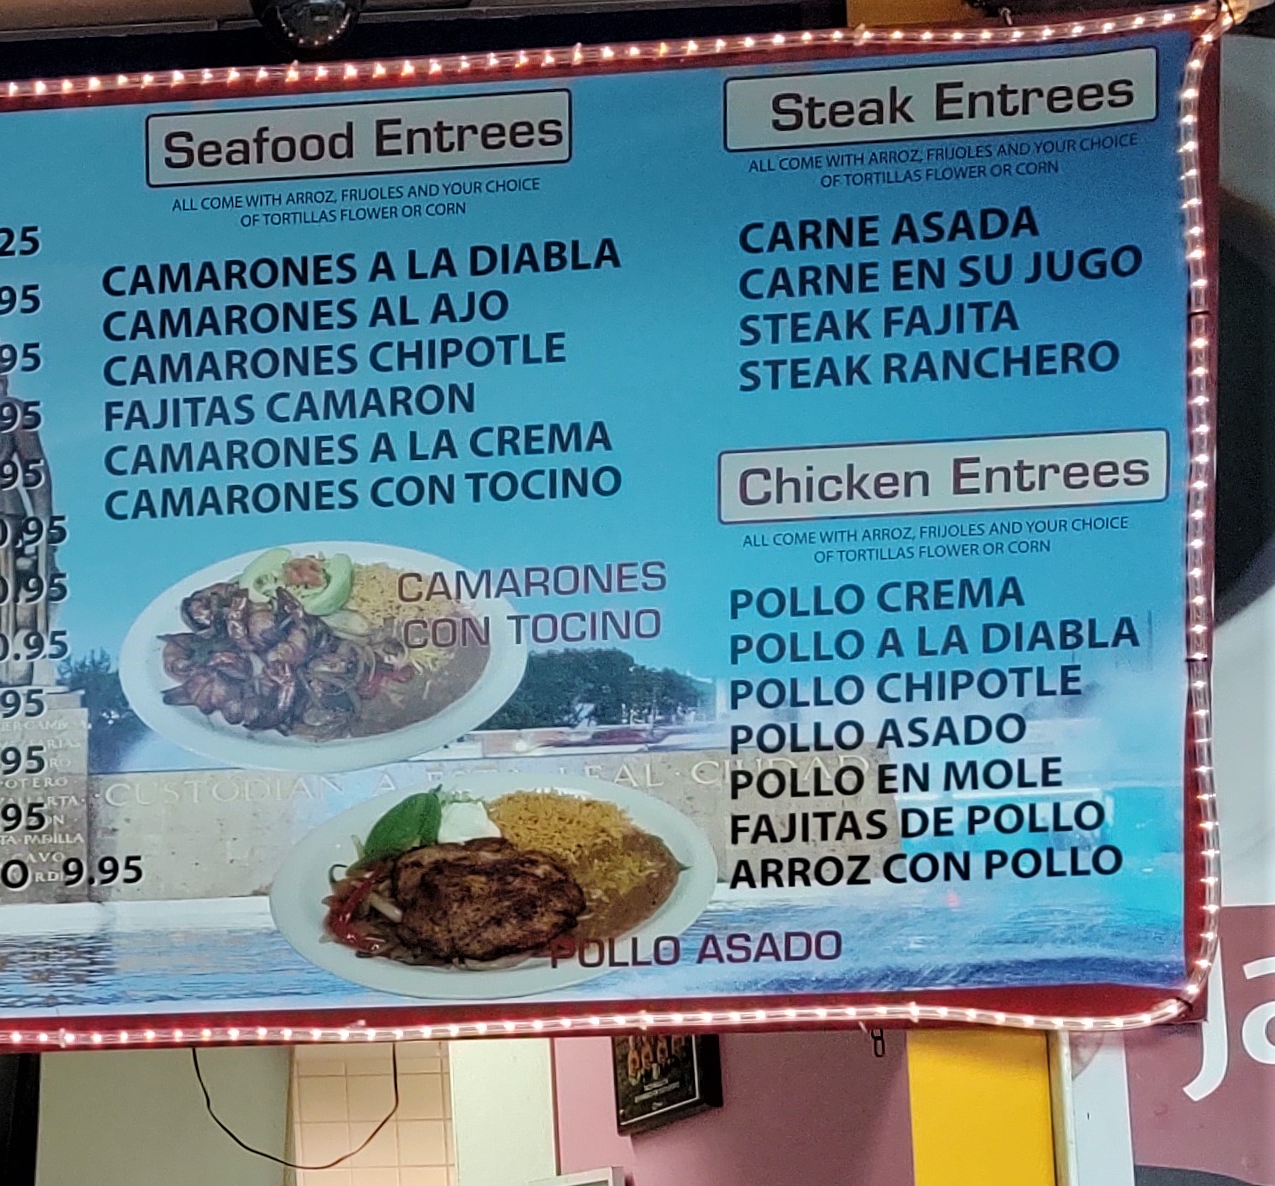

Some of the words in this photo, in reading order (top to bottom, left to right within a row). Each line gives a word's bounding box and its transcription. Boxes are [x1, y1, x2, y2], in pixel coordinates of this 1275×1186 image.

[771, 86, 915, 132] Steak
[936, 77, 1134, 121] Entrees
[164, 120, 354, 169] Seafood
[375, 117, 564, 158] Entrees
[172, 197, 196, 212] ALL
[200, 194, 243, 210] COME
[246, 192, 283, 208] WITH
[286, 190, 337, 206] ARROZ,
[341, 185, 404, 203] FRIJOLES
[407, 183, 441, 200] AND
[443, 181, 481, 198] YOUR
[485, 177, 540, 195] CHOICE
[241, 213, 260, 227] OF
[264, 208, 336, 225] TORTILLAS
[340, 205, 398, 223] FLOWER
[402, 203, 422, 219] OR
[426, 201, 466, 218] CORN
[739, 262, 880, 300] CARNE
[893, 258, 946, 292] EN
[959, 254, 1012, 287] SU
[1024, 245, 1143, 284] JUGO
[102, 297, 357, 341] CAMARONES
[369, 296, 420, 328] AL
[430, 290, 509, 324] AJO
[104, 394, 255, 431] FAJITAS
[266, 383, 475, 424] CAMARON
[738, 465, 930, 507] Chicken
[951, 457, 1150, 497] Entrees
[397, 561, 667, 603] CAMARONES
[403, 617, 490, 649] CON
[507, 609, 661, 645] TOCINO
[63, 855, 144, 888] 9.95
[729, 853, 871, 889] ARROZ
[883, 849, 972, 885] CON
[985, 844, 1123, 880] POLLO
[550, 935, 681, 969] POLLO
[696, 930, 842, 965] ASADO
